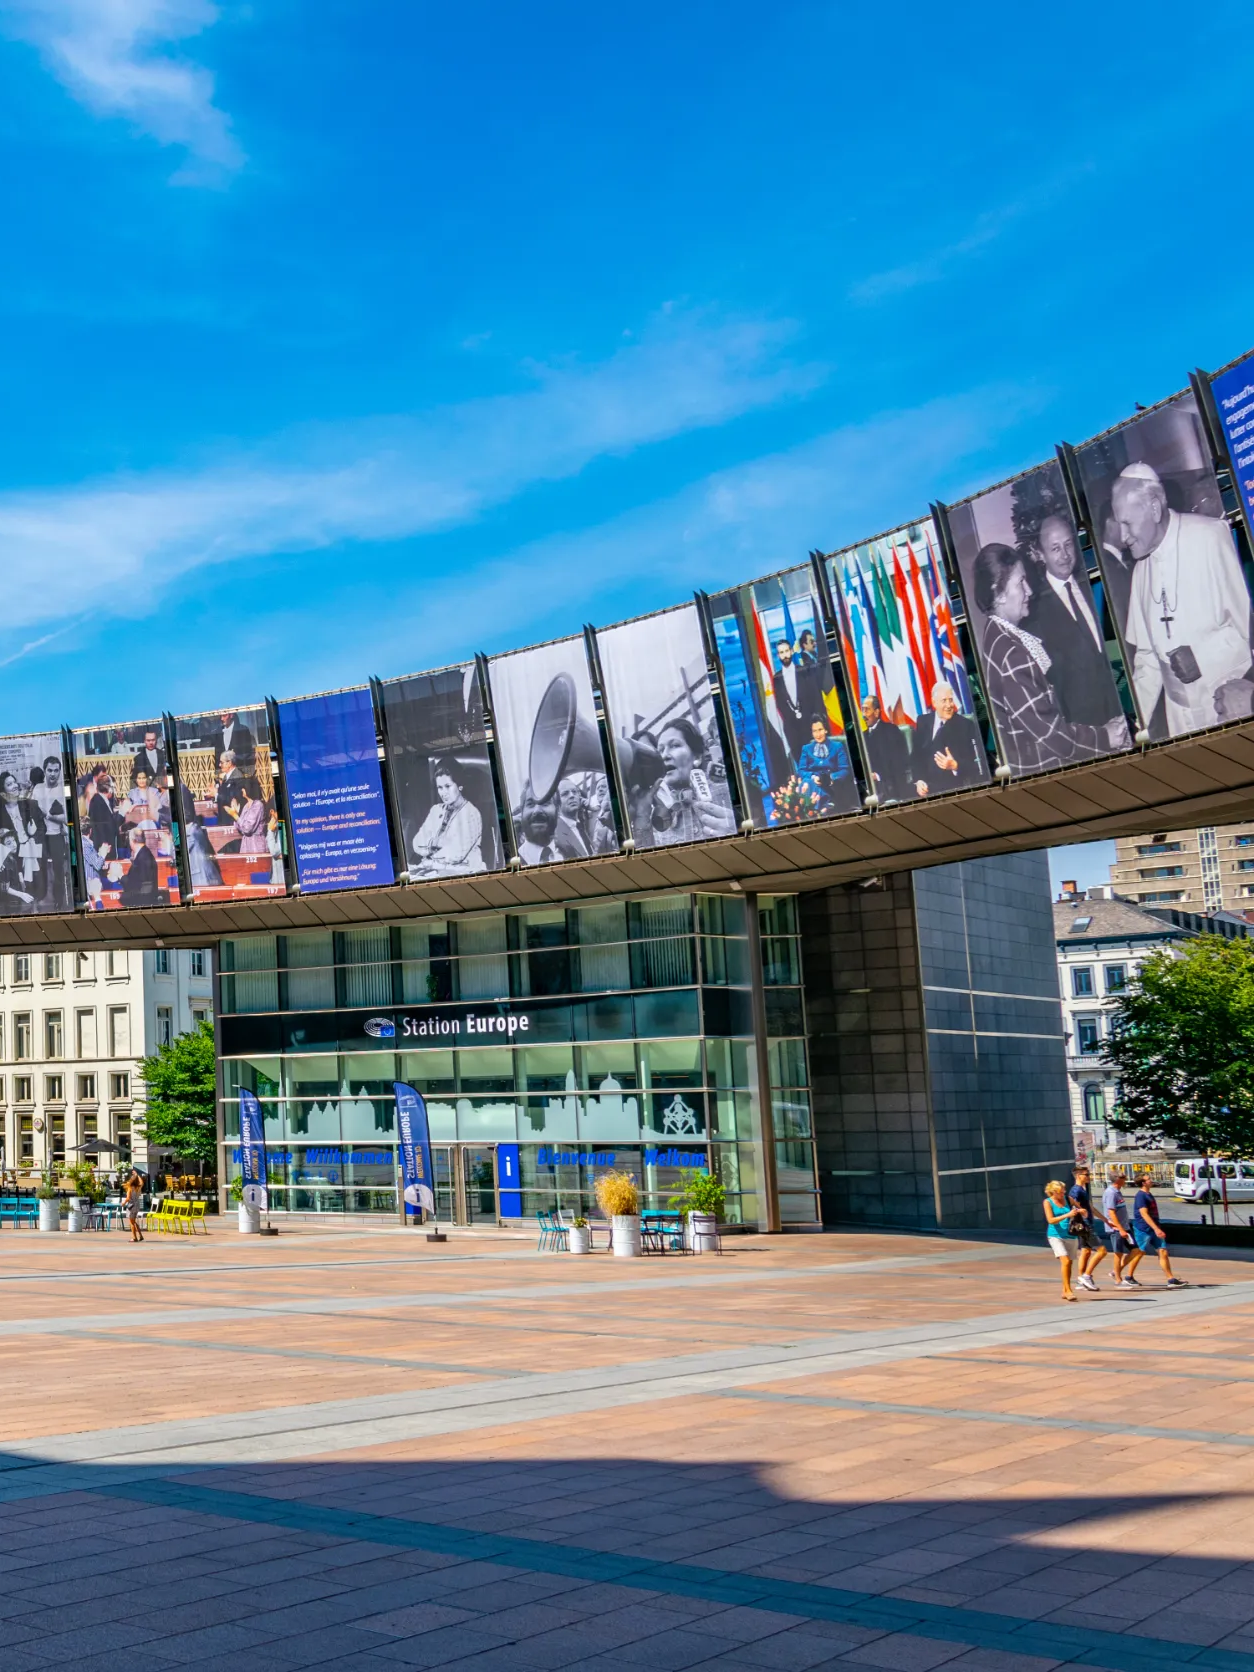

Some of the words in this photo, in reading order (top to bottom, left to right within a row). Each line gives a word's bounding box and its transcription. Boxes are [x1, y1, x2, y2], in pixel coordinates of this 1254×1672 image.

[292, 801, 310, 809] solution
[322, 823, 337, 831] Europe
[402, 1016, 460, 1036] Station
[466, 1014, 529, 1036] Europe
[233, 1150, 293, 1164] Wome
[306, 1149, 393, 1164] Willkommen
[537, 1148, 616, 1166] Bienvenue
[646, 1148, 705, 1166] Welkom
